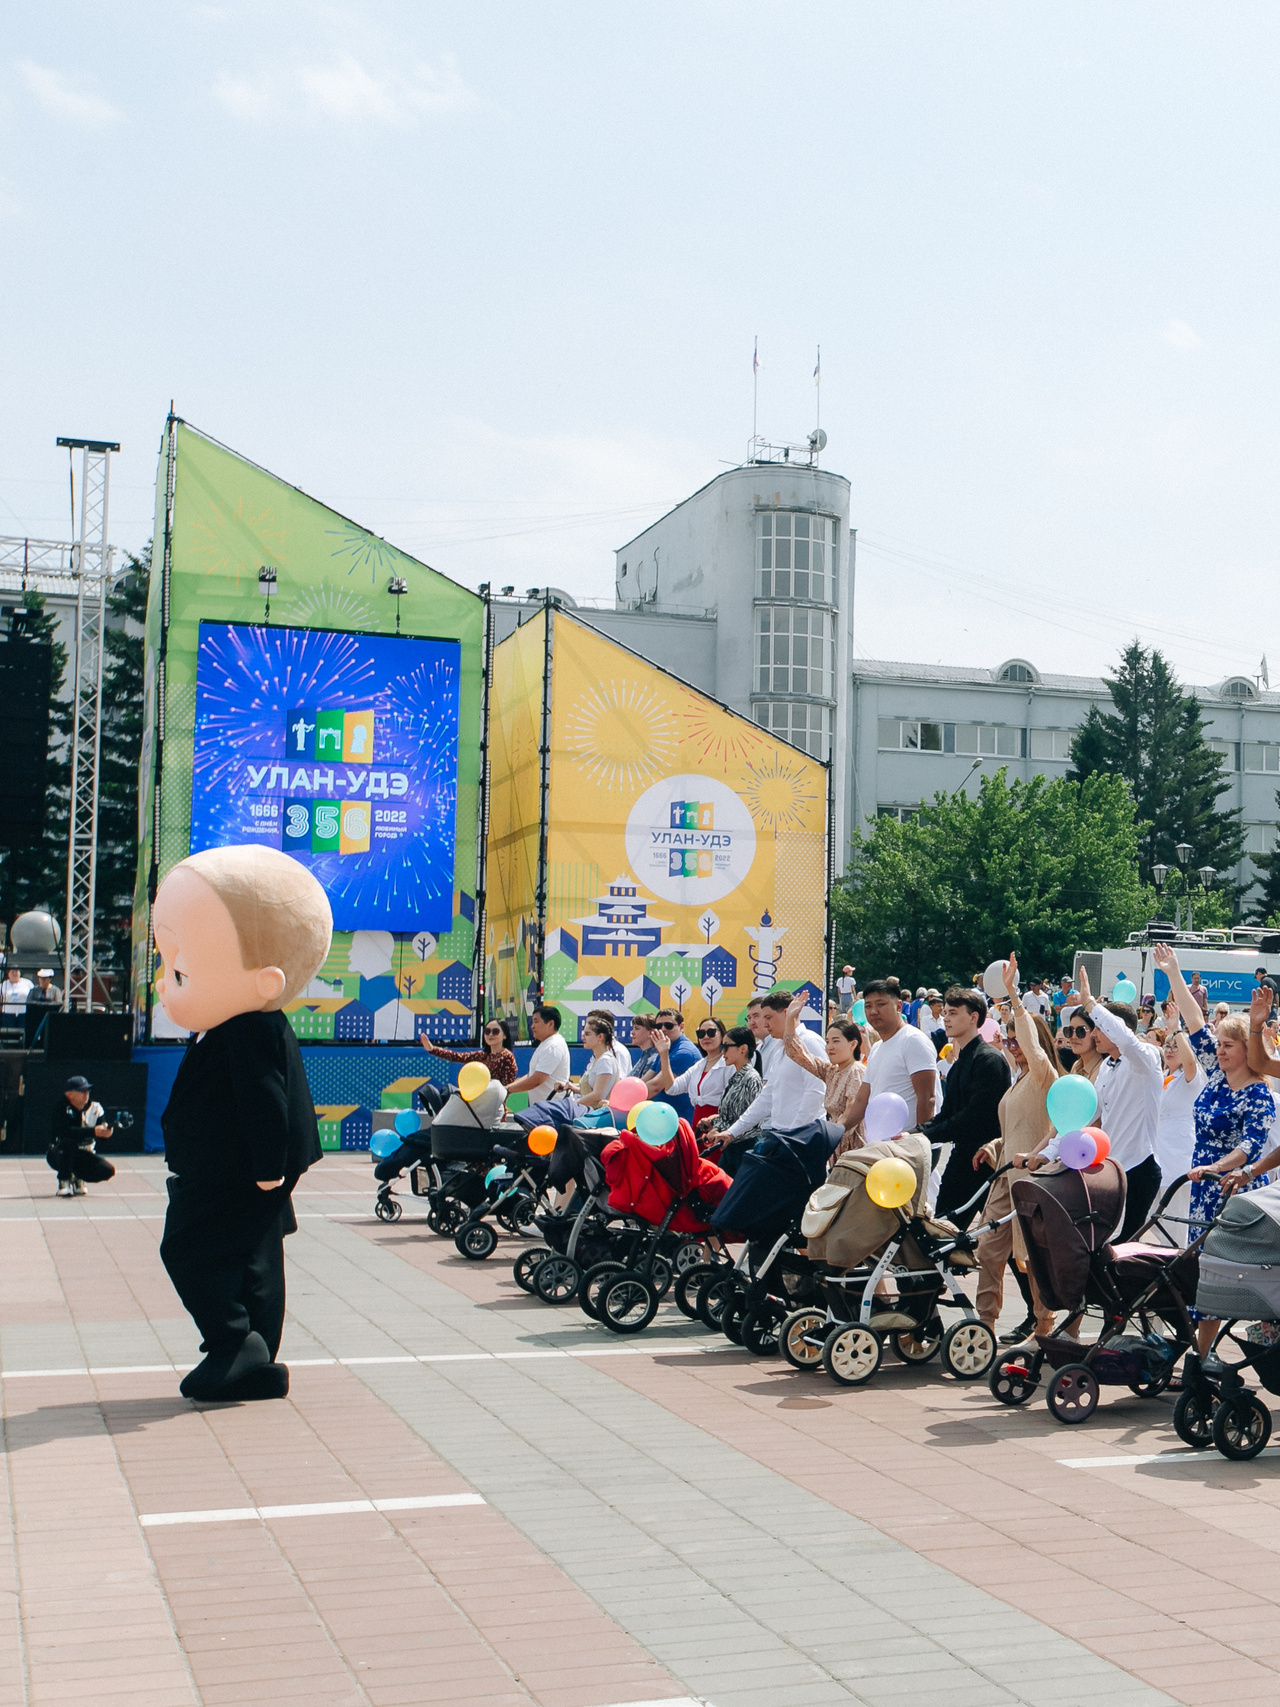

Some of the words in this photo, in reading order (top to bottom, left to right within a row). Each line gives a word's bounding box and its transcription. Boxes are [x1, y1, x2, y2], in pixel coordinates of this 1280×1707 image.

[247, 765, 409, 799] УЛАН-УДЭ
[250, 804, 278, 817] 1666
[375, 810, 406, 822] 2022
[286, 804, 368, 840] 356
[651, 832, 731, 848] УЛАН-УДЭ
[1201, 979, 1242, 989] РИГУС
